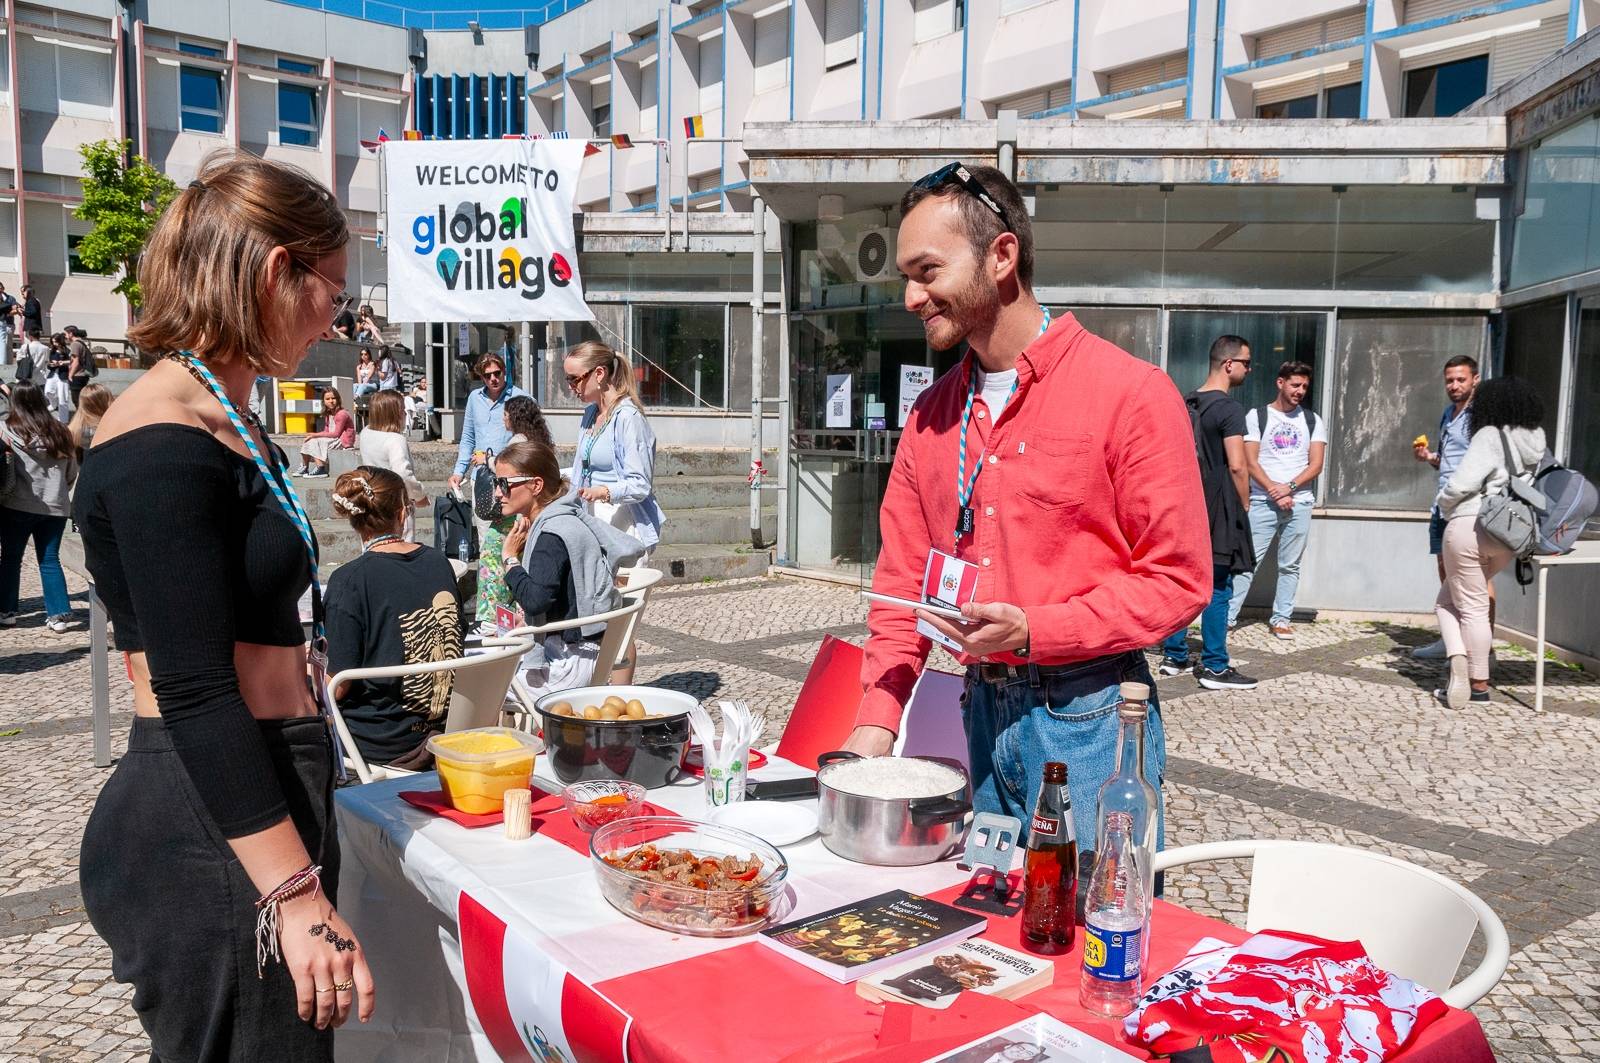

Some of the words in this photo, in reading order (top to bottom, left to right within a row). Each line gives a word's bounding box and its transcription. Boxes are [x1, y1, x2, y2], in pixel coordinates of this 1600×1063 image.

[416, 163, 528, 186] WELCOME
[530, 169, 559, 191] TO
[412, 197, 528, 255] global
[440, 247, 571, 300] village
[897, 900, 922, 910] Mario
[961, 942, 991, 956] RELATOS
[991, 954, 1038, 974] COMPLETOS
